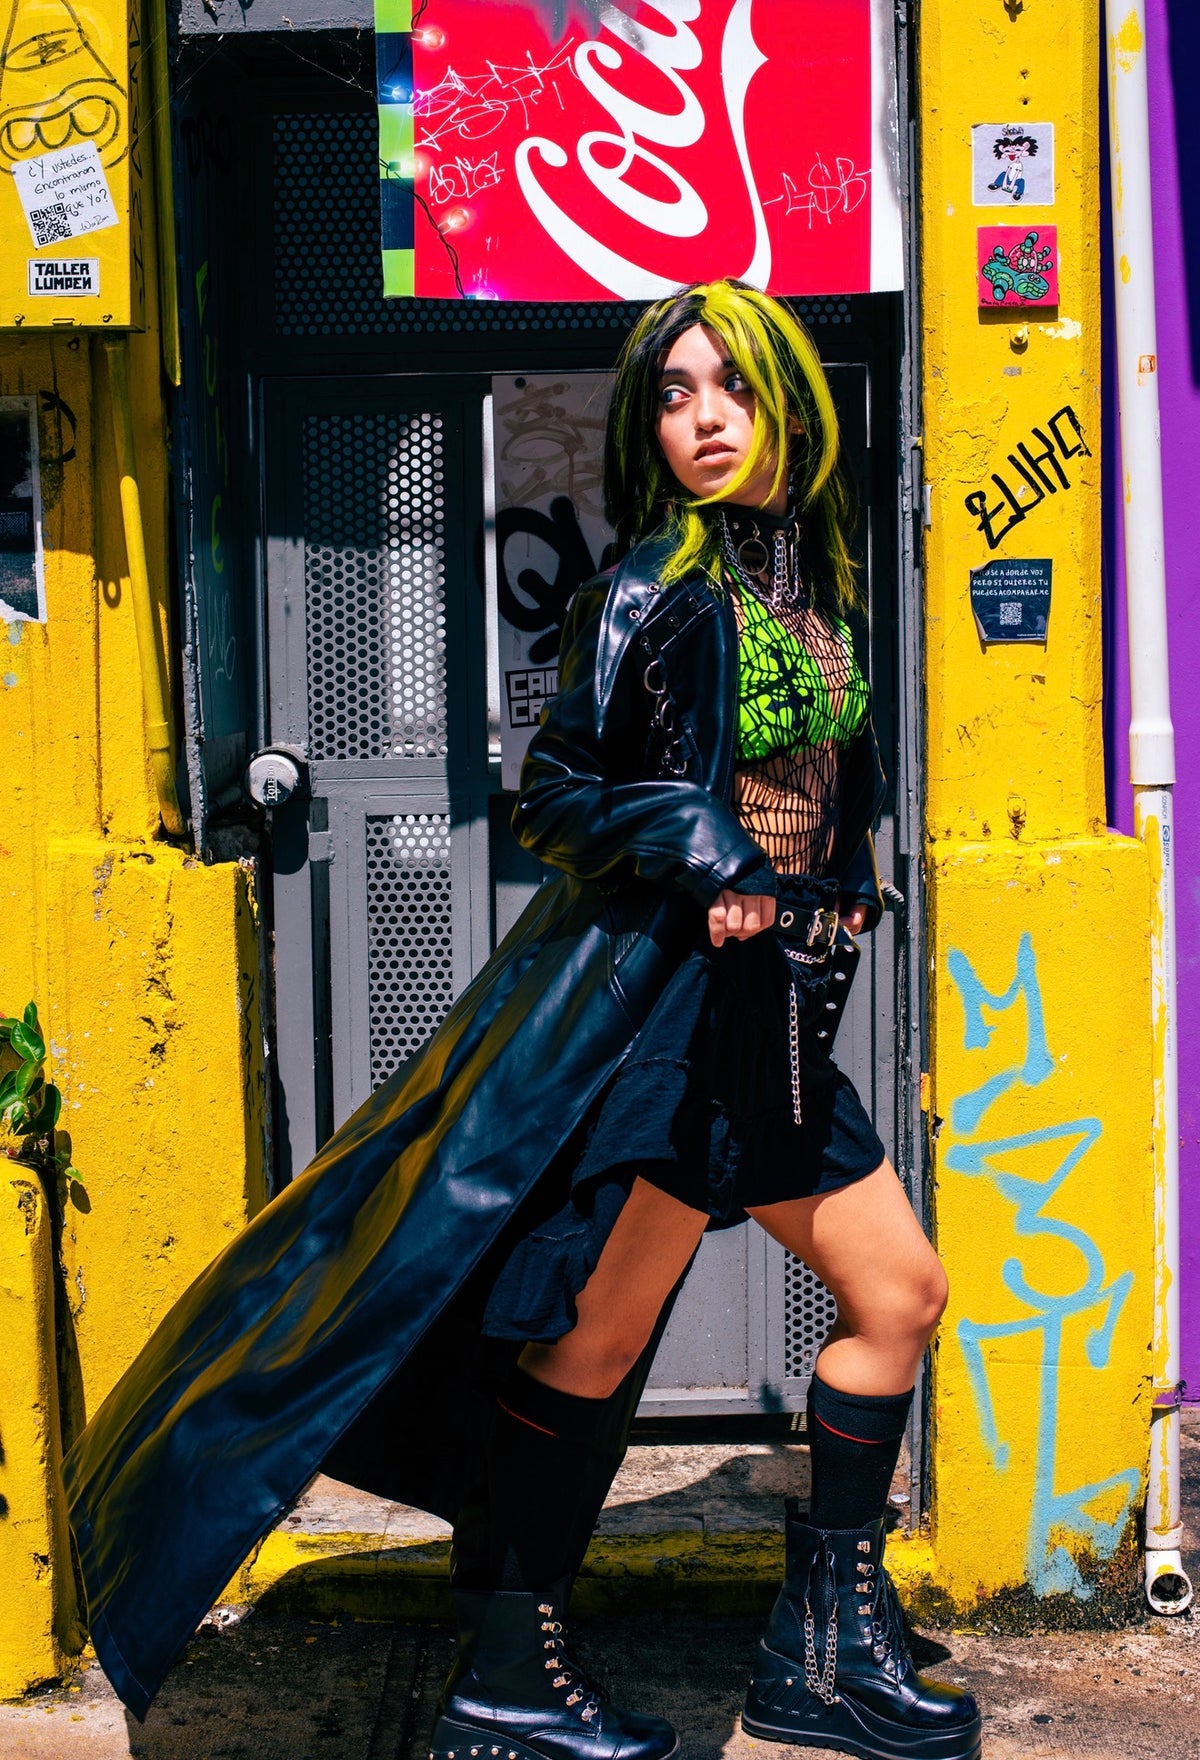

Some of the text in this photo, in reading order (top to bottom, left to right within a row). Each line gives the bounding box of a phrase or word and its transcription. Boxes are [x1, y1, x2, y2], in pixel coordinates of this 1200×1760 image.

[54, 180, 101, 201] lo mismo
[34, 263, 90, 276] TALLER
[35, 277, 92, 290] LUMPEN
